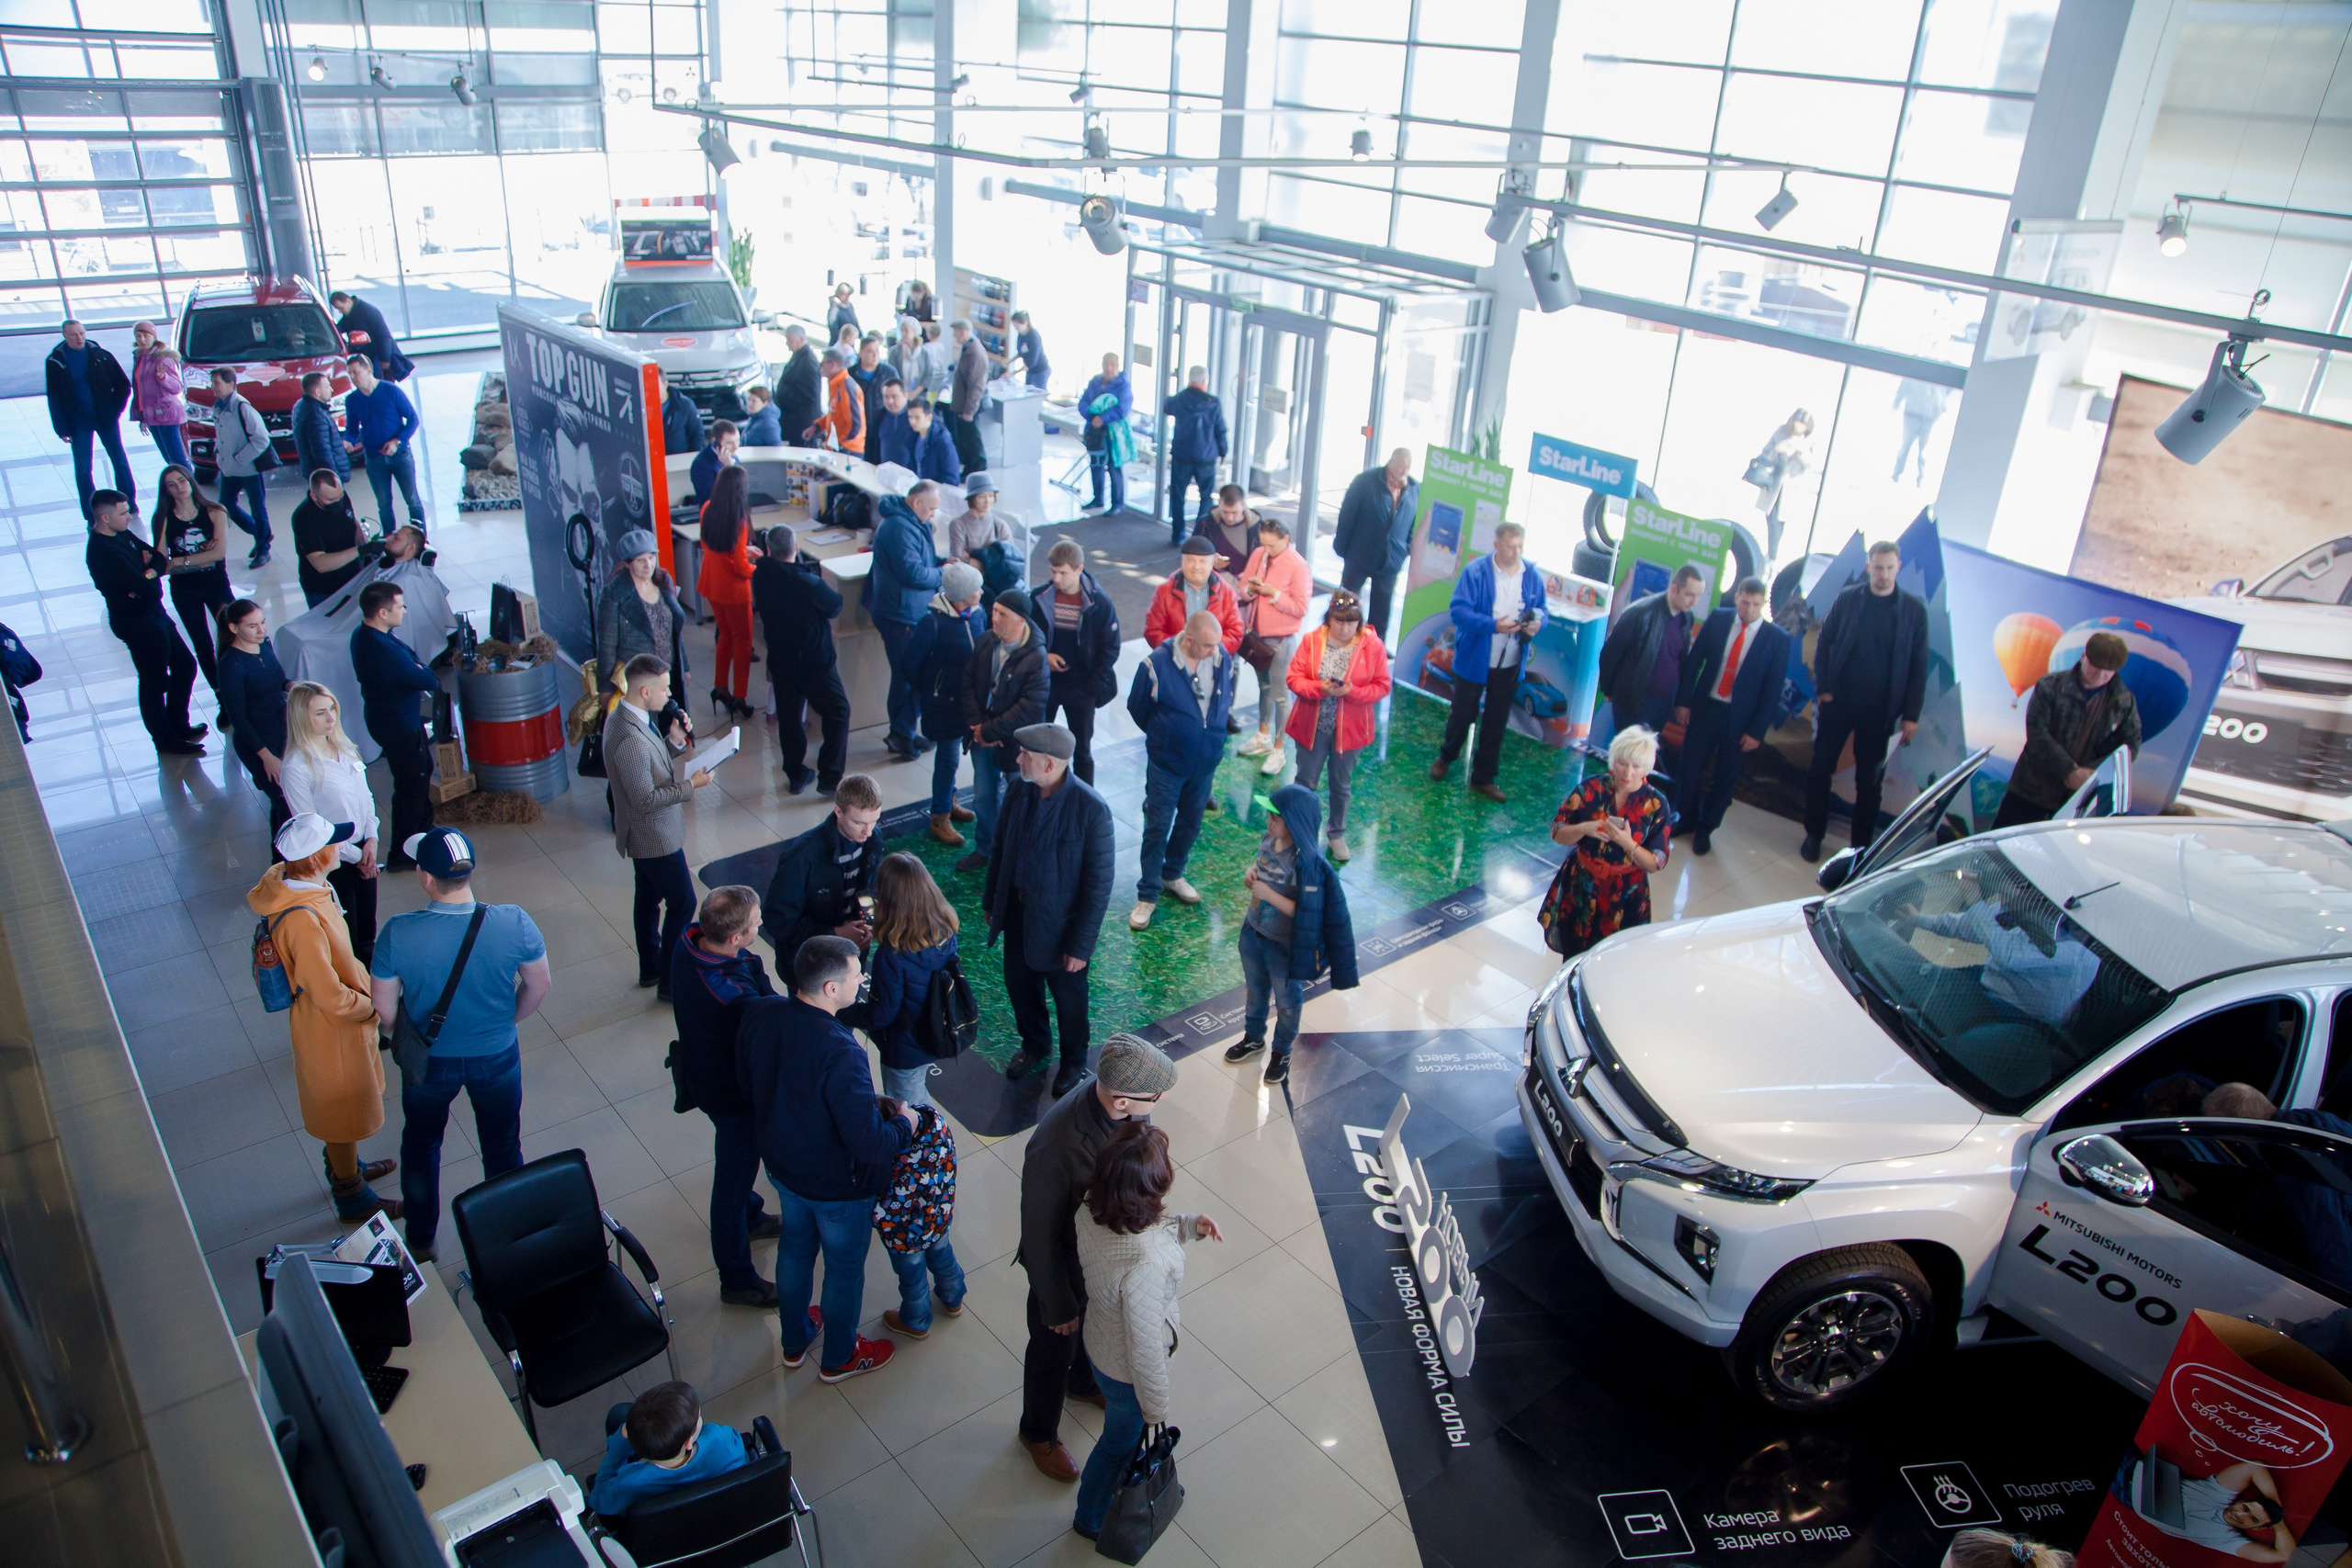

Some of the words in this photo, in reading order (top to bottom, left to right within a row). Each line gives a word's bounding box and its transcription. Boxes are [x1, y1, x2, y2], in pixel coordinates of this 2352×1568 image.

[1430, 449, 1507, 489] StarLine
[1538, 445, 1622, 486] StarLine
[1633, 504, 1722, 549] StarLine
[1416, 1053, 1461, 1063] Select
[1416, 1061, 1511, 1073] Трансмиссия
[1464, 1051, 1506, 1061] Super
[1534, 1078, 1563, 1138] L200
[2052, 1211, 2126, 1258] MITSUBISHI
[2126, 1251, 2183, 1290] MOTORS
[2018, 1223, 2178, 1326] L200
[1391, 1266, 1426, 1320] НОВАЯ
[1412, 1324, 1449, 1390] ФОРМА
[1435, 1392, 1470, 1448] СИЛЫ
[2218, 1401, 2300, 1445] хочу
[2003, 1478, 2096, 1498] Подогрев
[1703, 1510, 1781, 1529] Камера
[2018, 1503, 2065, 1522] руля
[1713, 1529, 1797, 1551] заднего
[1801, 1525, 1852, 1542] вида
[2114, 1510, 2139, 1544] Стоит
[2139, 1543, 2171, 1568] толь
[2121, 1537, 2156, 1568] захот
